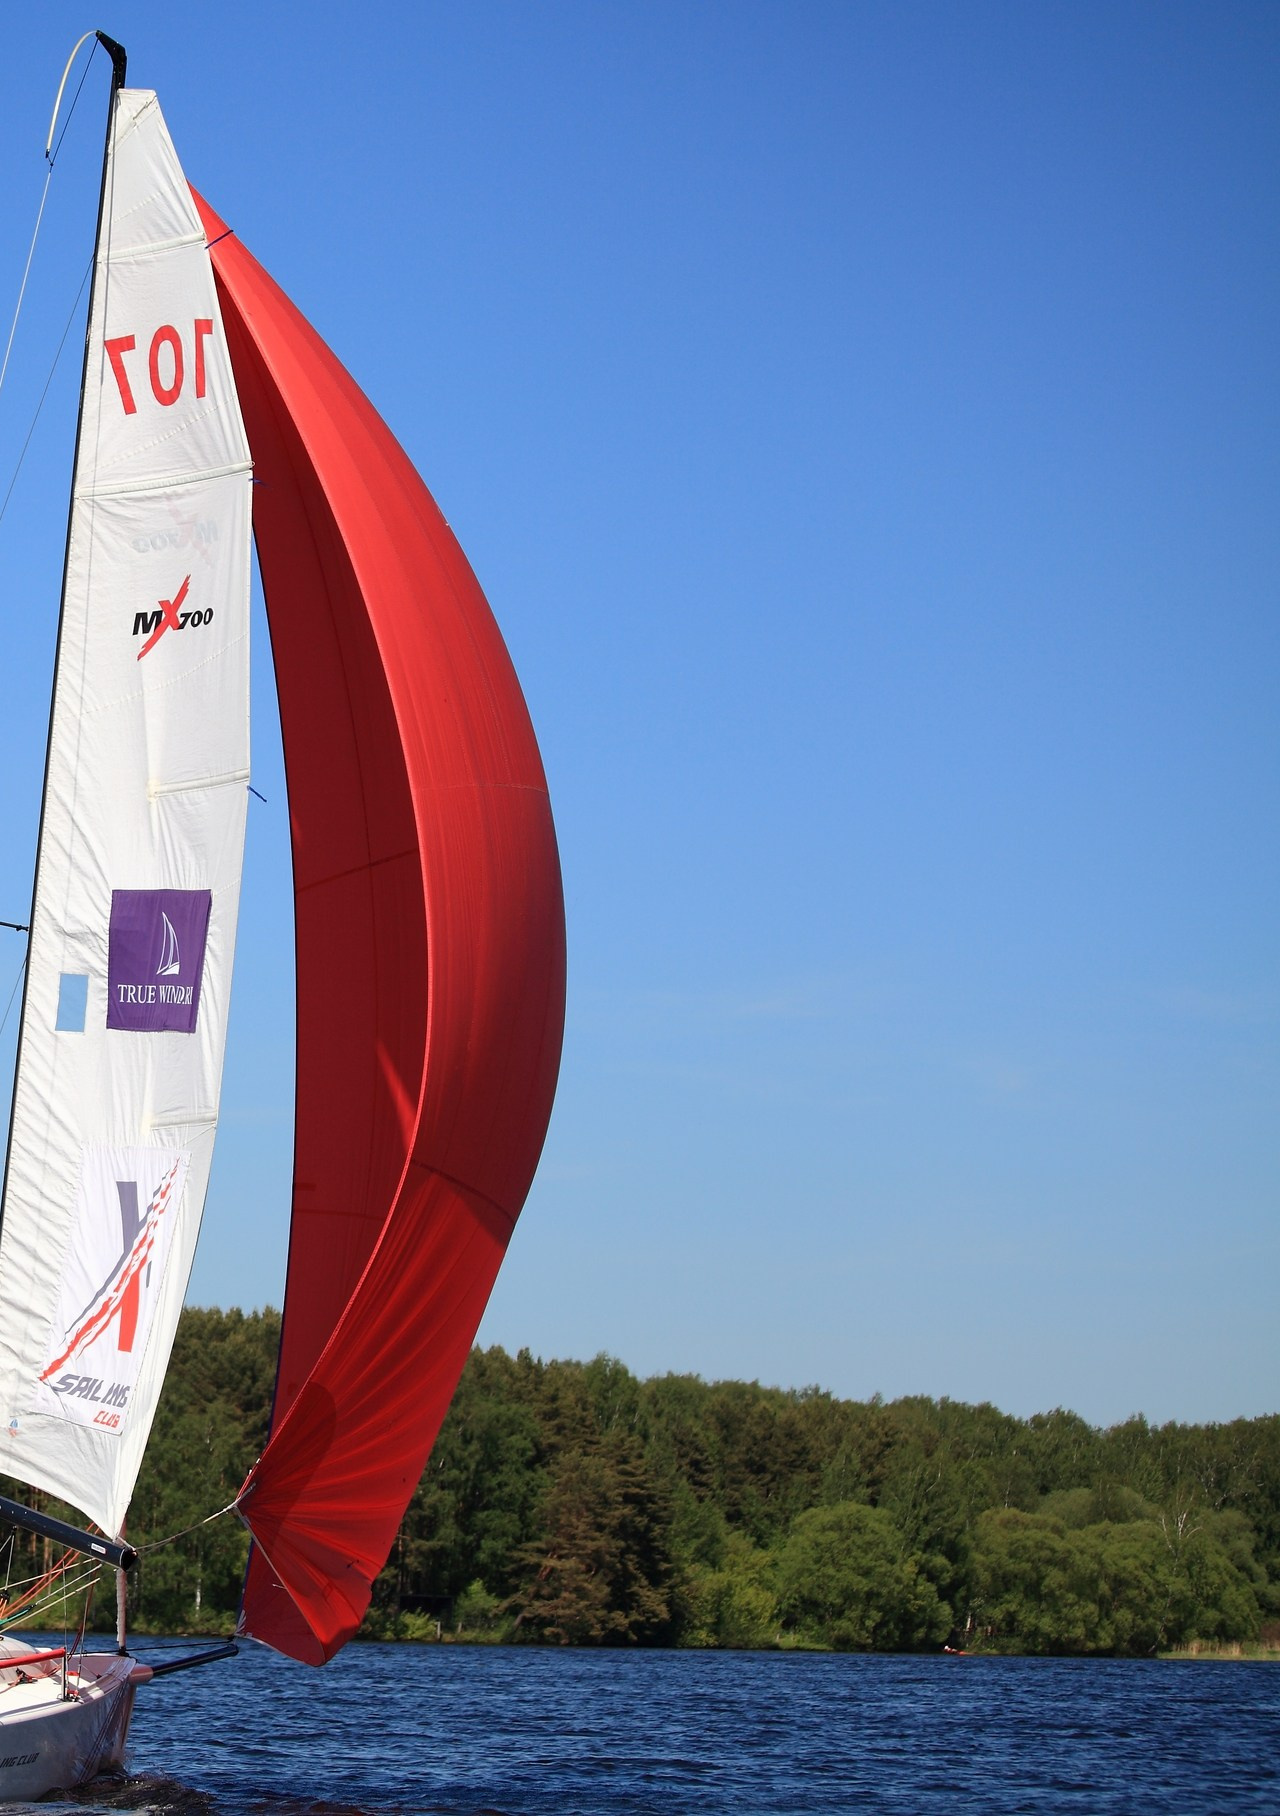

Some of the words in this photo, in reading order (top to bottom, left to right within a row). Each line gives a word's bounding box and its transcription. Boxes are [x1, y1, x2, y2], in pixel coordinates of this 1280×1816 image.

[132, 574, 214, 661] MX700
[117, 984, 157, 1004] TRUE
[52, 1373, 131, 1409] SAILING
[93, 1410, 121, 1429] CLUB
